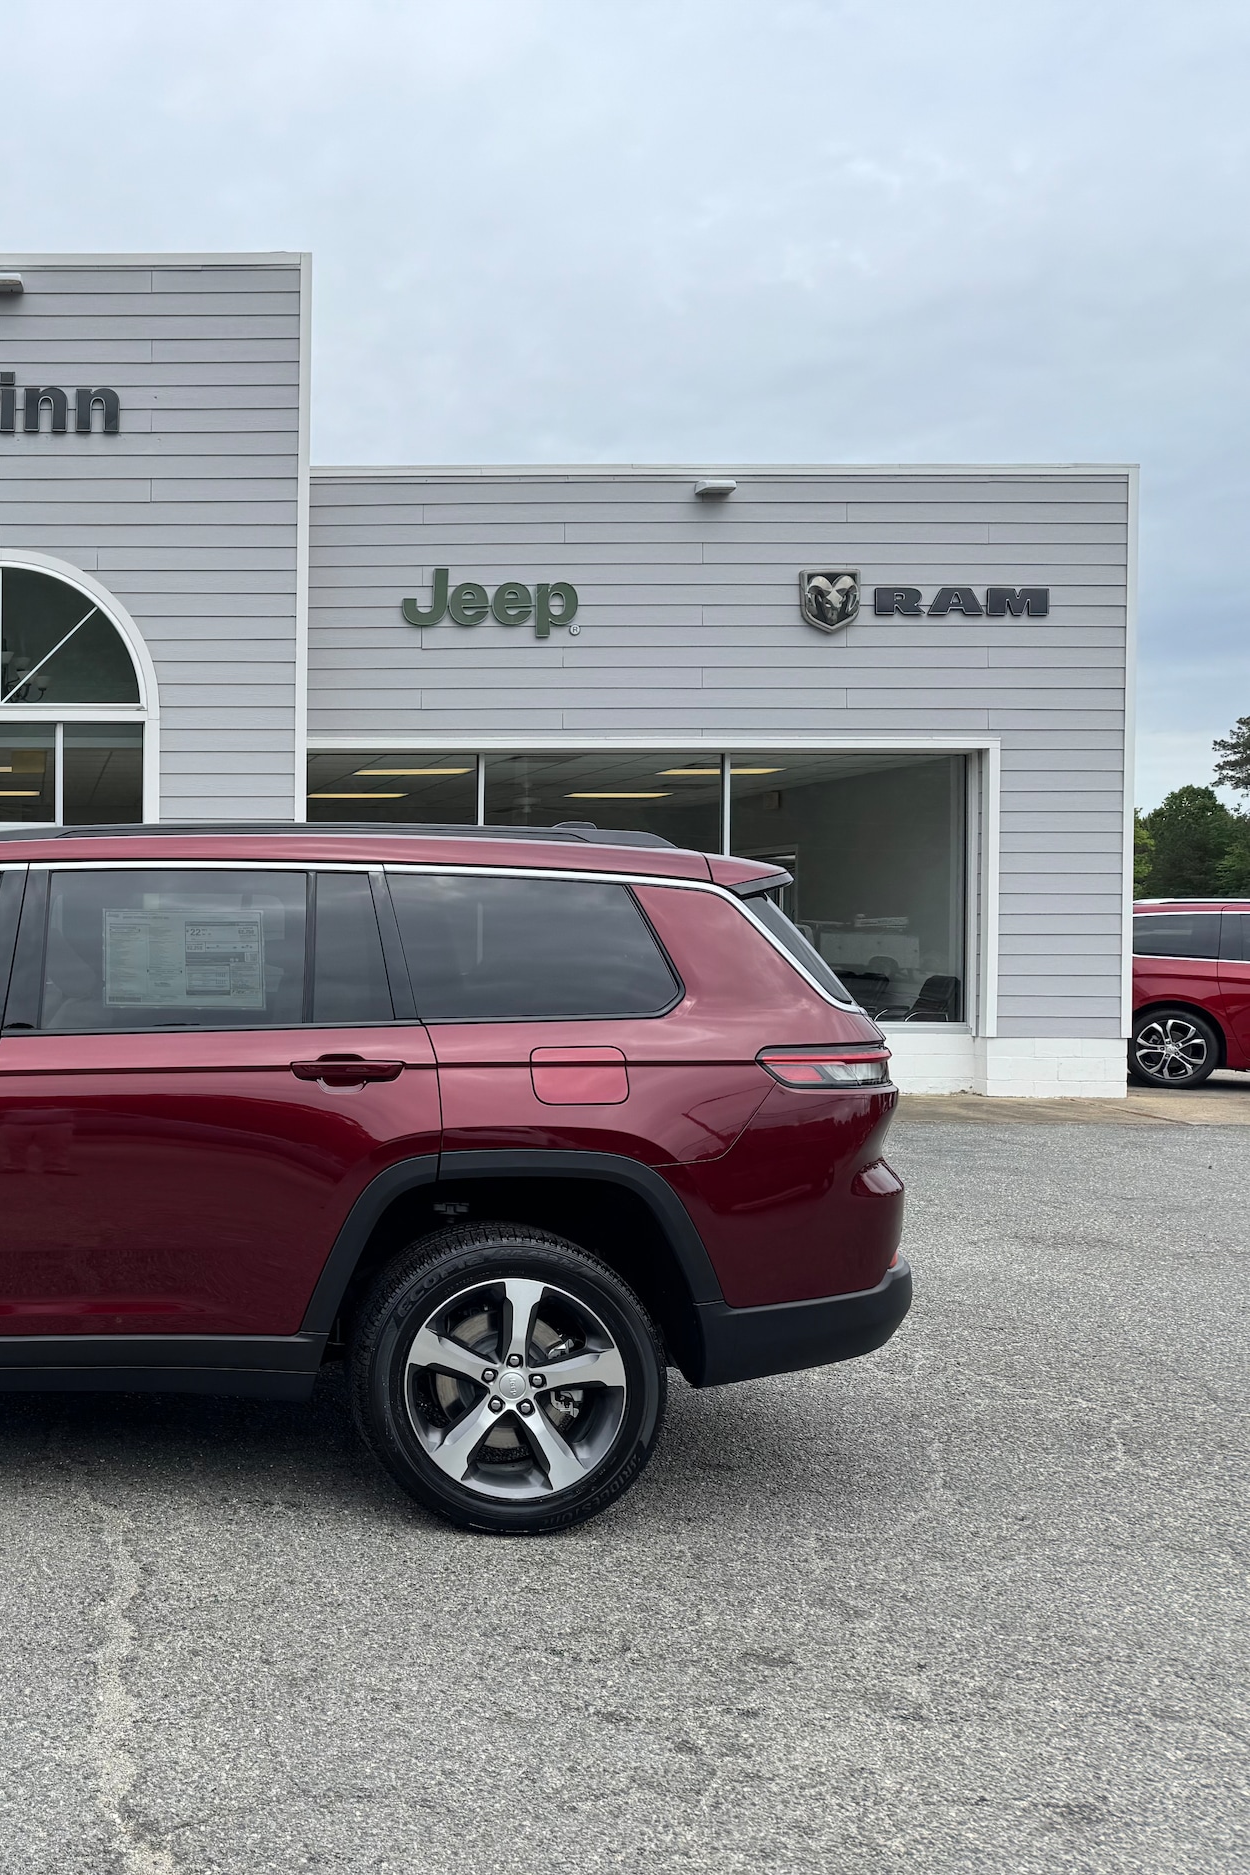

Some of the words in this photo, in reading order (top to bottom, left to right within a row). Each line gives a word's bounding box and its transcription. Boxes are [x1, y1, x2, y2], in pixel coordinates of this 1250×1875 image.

[402, 568, 579, 638] Jeep
[875, 587, 1050, 616] RAM
[190, 928, 202, 937] 22
[508, 1375, 518, 1396] Jeep
